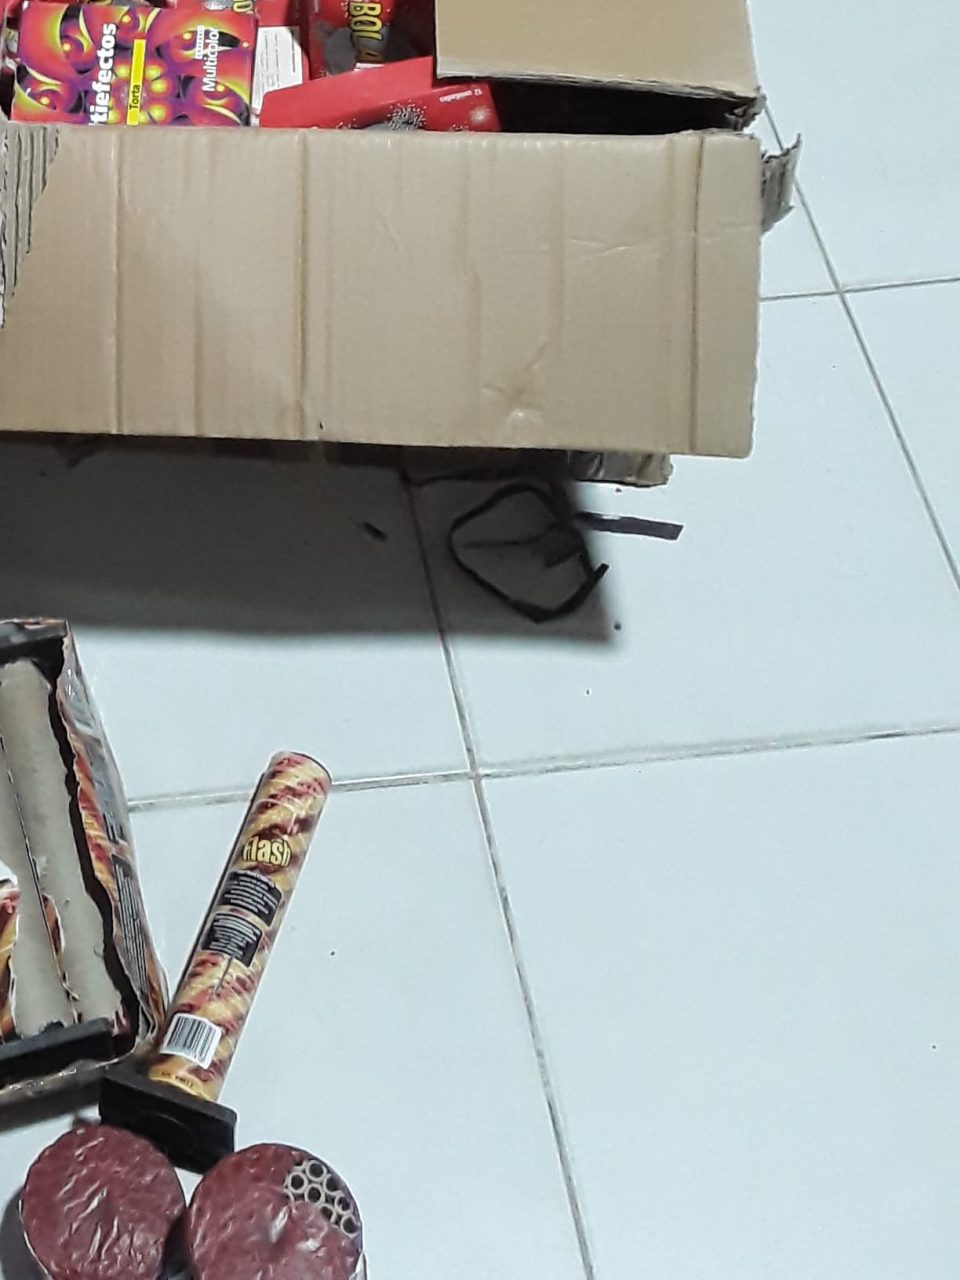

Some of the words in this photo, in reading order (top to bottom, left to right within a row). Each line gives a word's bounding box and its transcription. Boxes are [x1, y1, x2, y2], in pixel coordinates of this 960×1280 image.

[202, 27, 220, 92] Multicolor
[348, 1, 384, 62] BOLA
[88, 23, 117, 125] tiefectos
[129, 84, 141, 110] Torta
